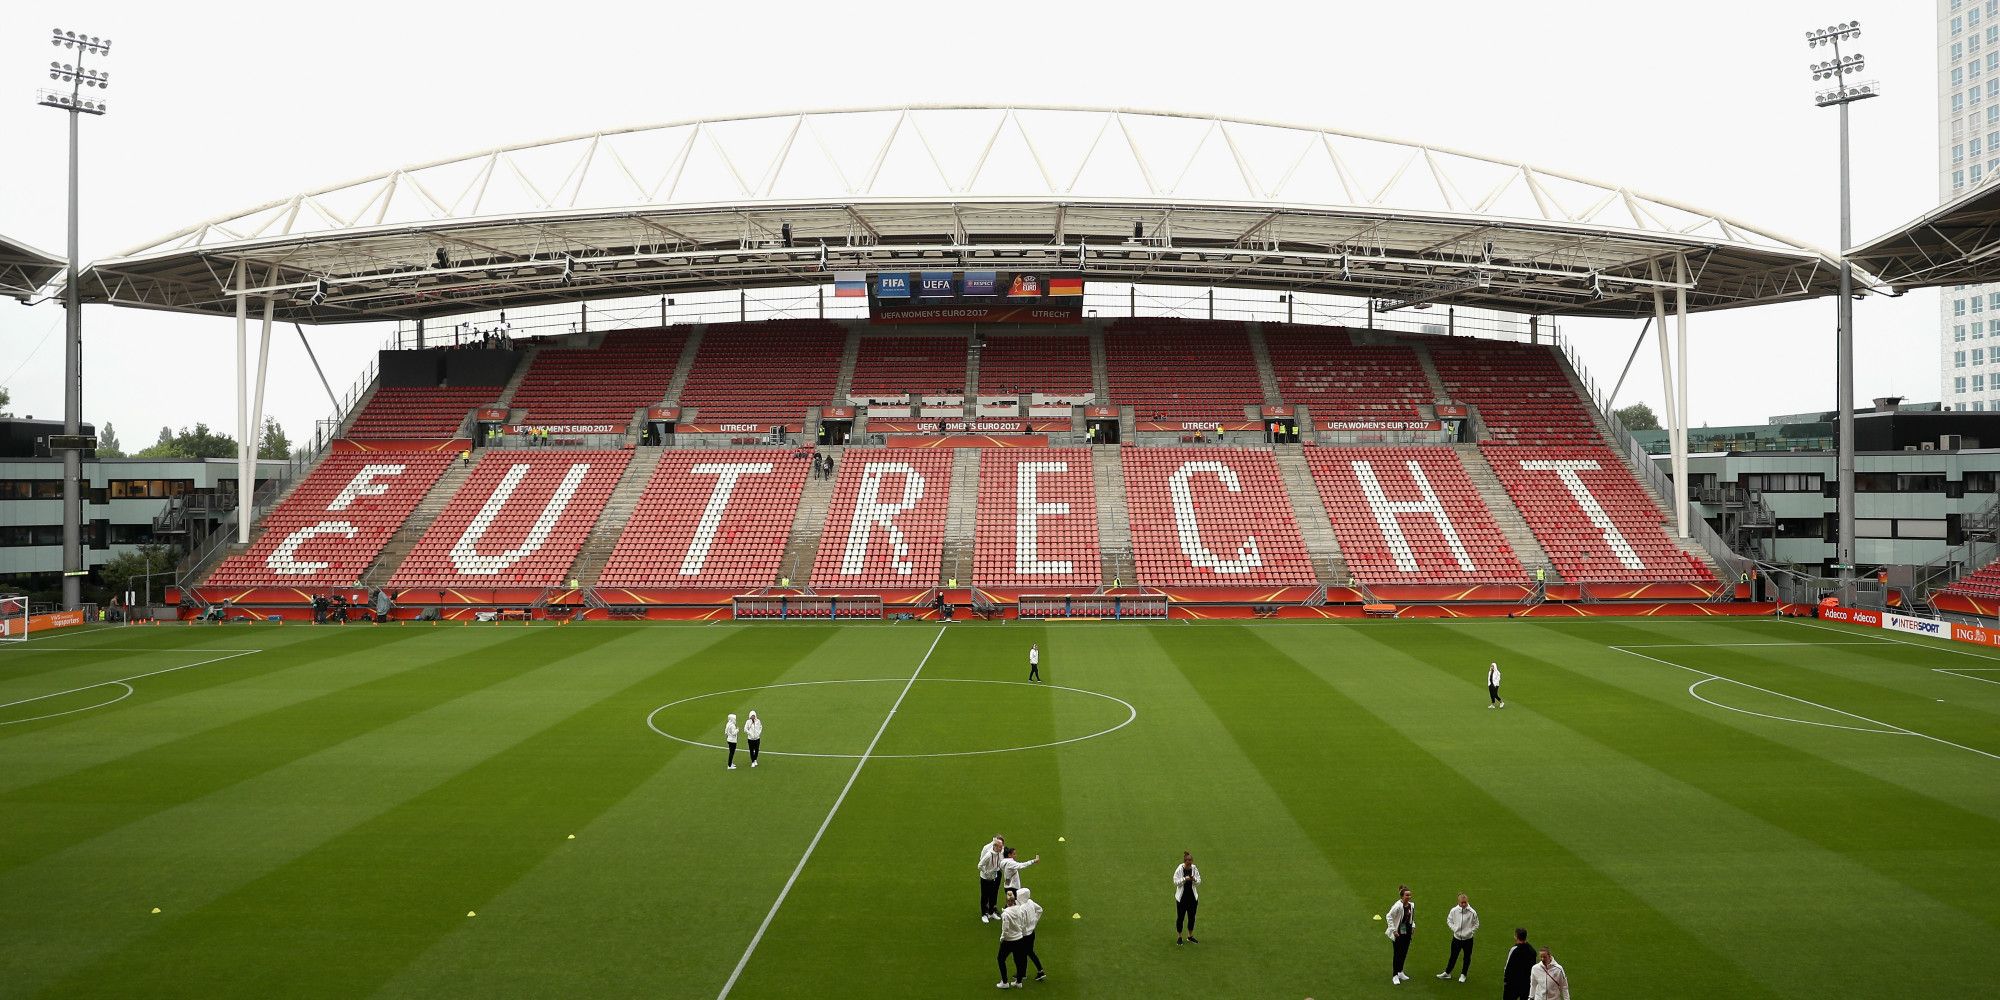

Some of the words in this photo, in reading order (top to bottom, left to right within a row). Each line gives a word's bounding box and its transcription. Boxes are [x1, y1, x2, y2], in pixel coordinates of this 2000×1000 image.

[882, 279, 905, 288] FIFA
[923, 280, 950, 289] UEFA
[966, 309, 988, 317] 2017
[1031, 310, 1071, 318] UTRECHT
[571, 425, 592, 433] EURO
[720, 424, 758, 432] UTRECHT
[917, 422, 938, 430] UEFA
[977, 422, 999, 430] EURO
[1000, 422, 1020, 430] 2017
[1182, 422, 1220, 430] UTRECHT
[1824, 608, 1848, 620] Adecco
[1853, 612, 1877, 624] Adecco
[1898, 617, 1940, 634] INTERSPORT
[1956, 628, 1974, 641] ING
